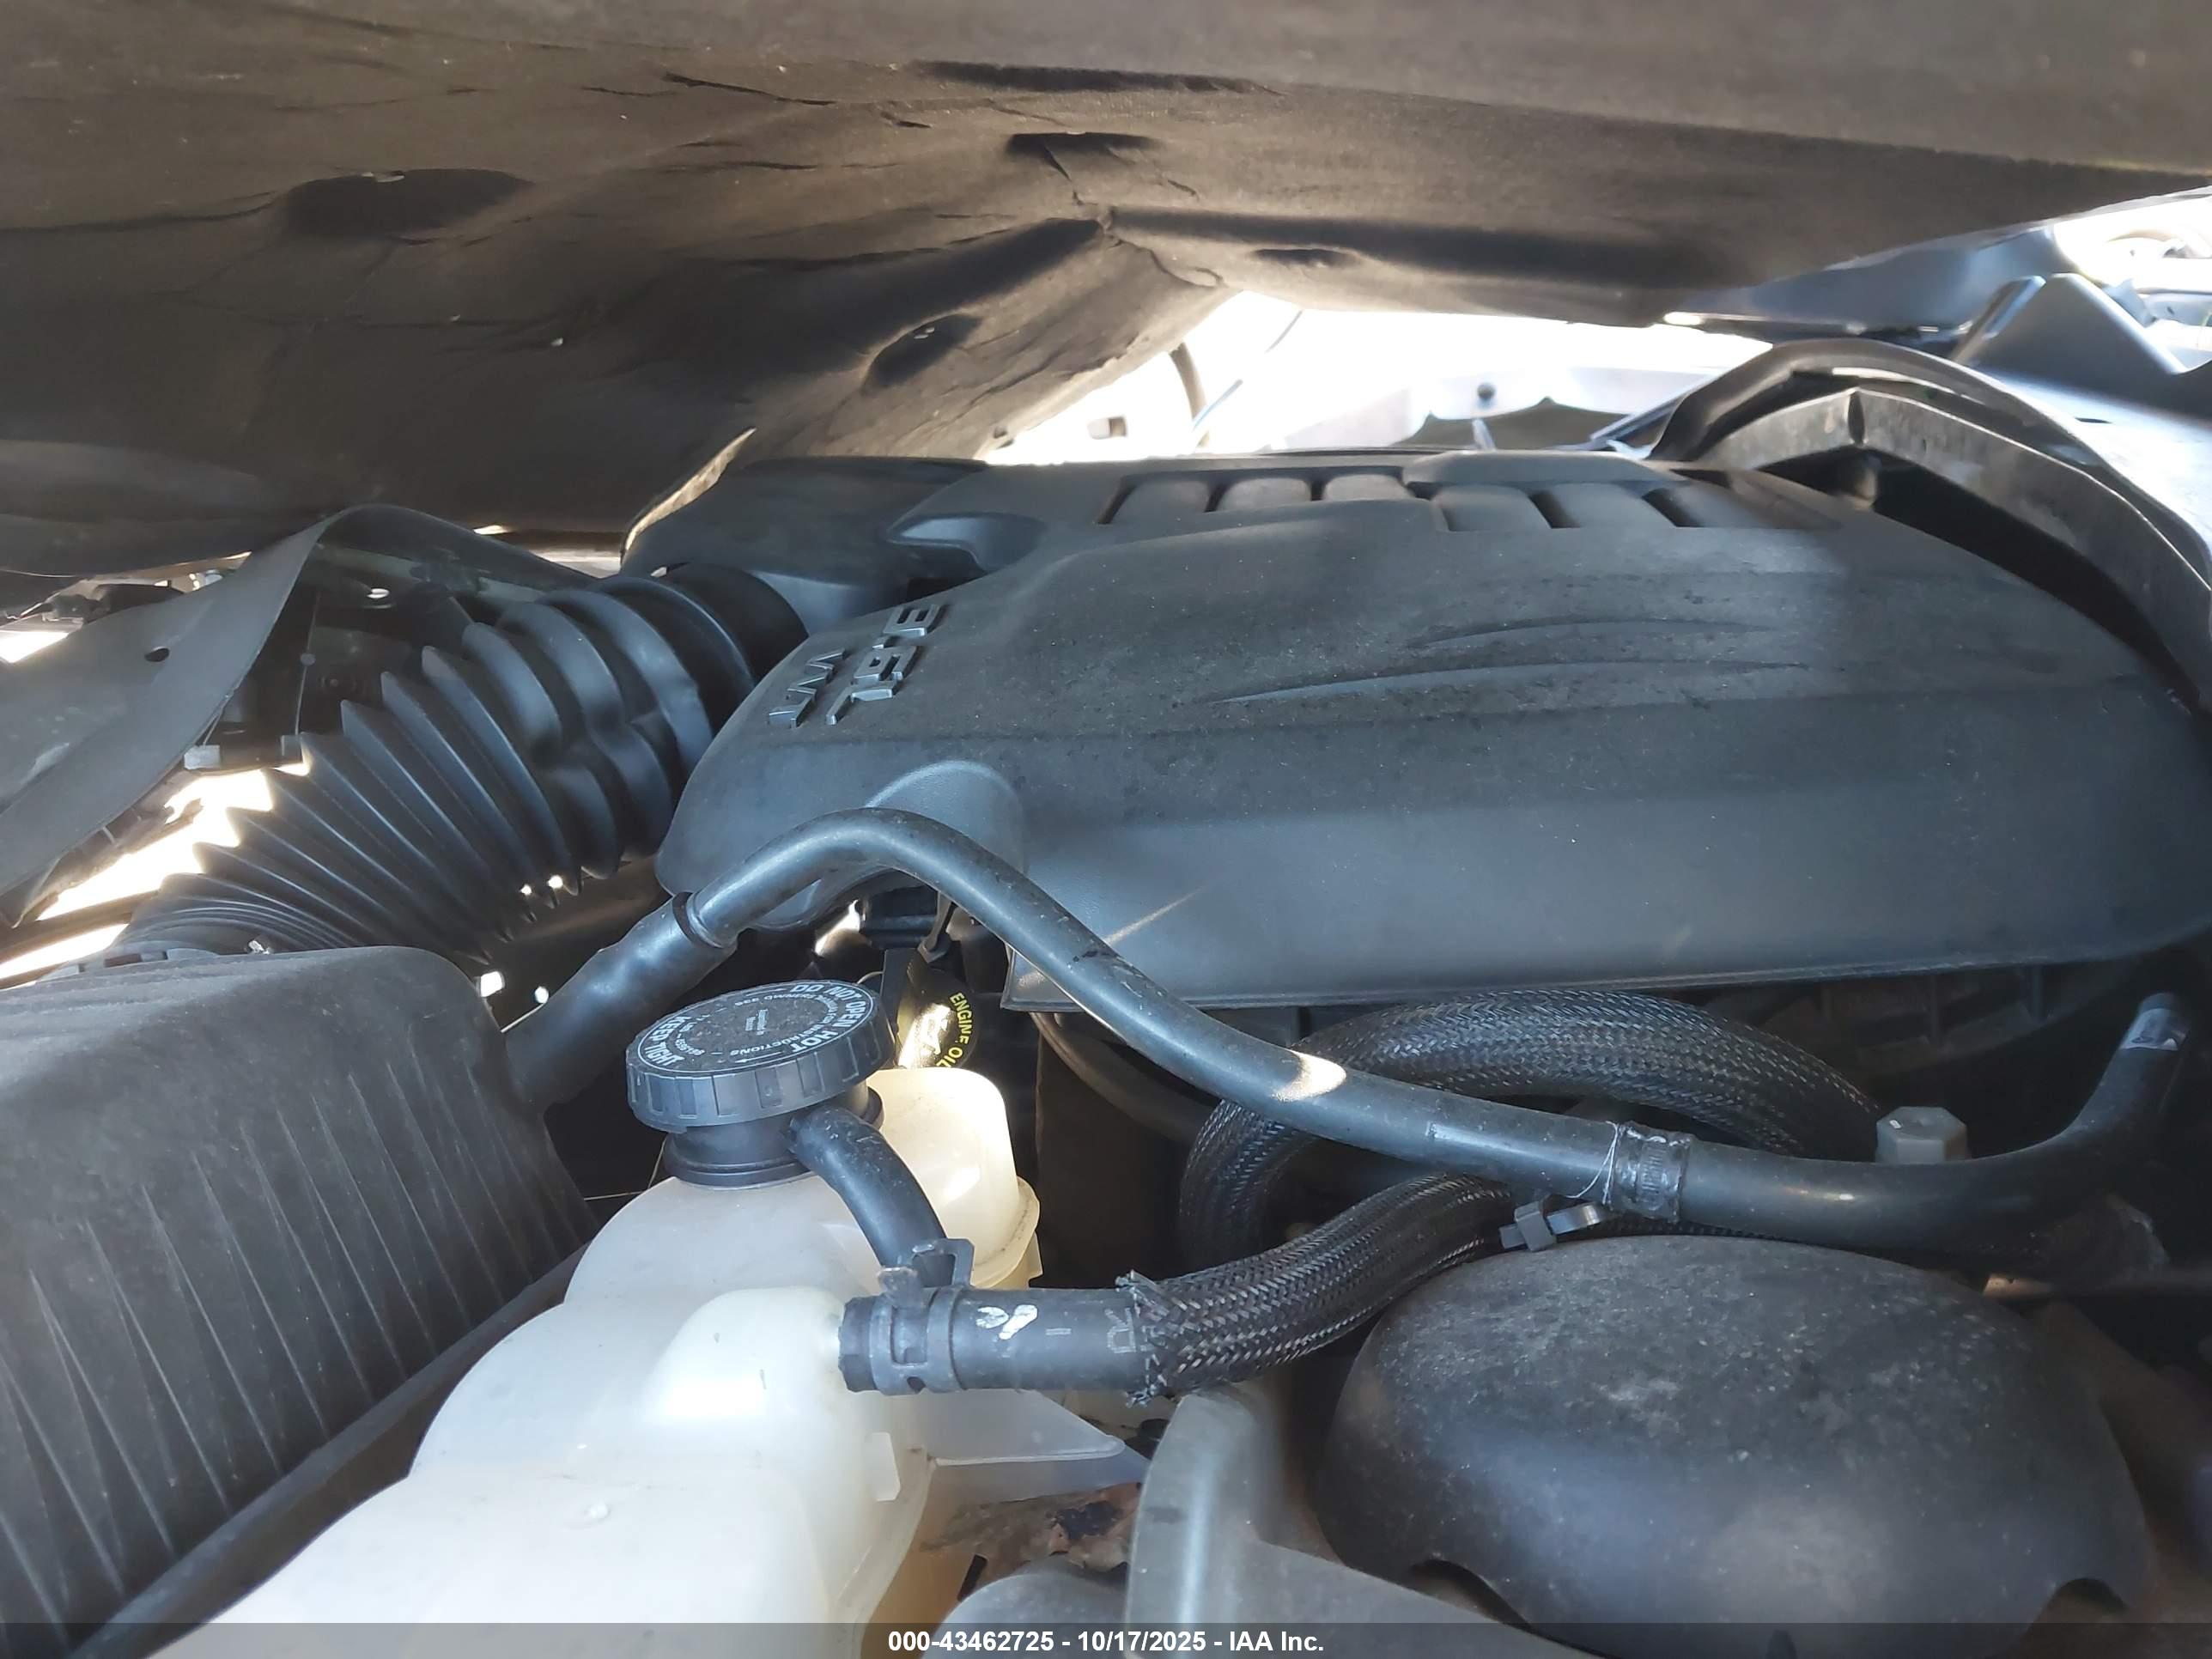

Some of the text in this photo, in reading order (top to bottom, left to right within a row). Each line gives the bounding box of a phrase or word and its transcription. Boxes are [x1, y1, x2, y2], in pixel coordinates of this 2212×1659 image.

[769, 647, 847, 728] VVT
[823, 986, 862, 1000] NOT
[831, 1000, 866, 1027] OPEN
[936, 992, 973, 1067] ENGINE OIL
[644, 1017, 691, 1066] KEEP TIGHT
[791, 1030, 838, 1052] HOT
